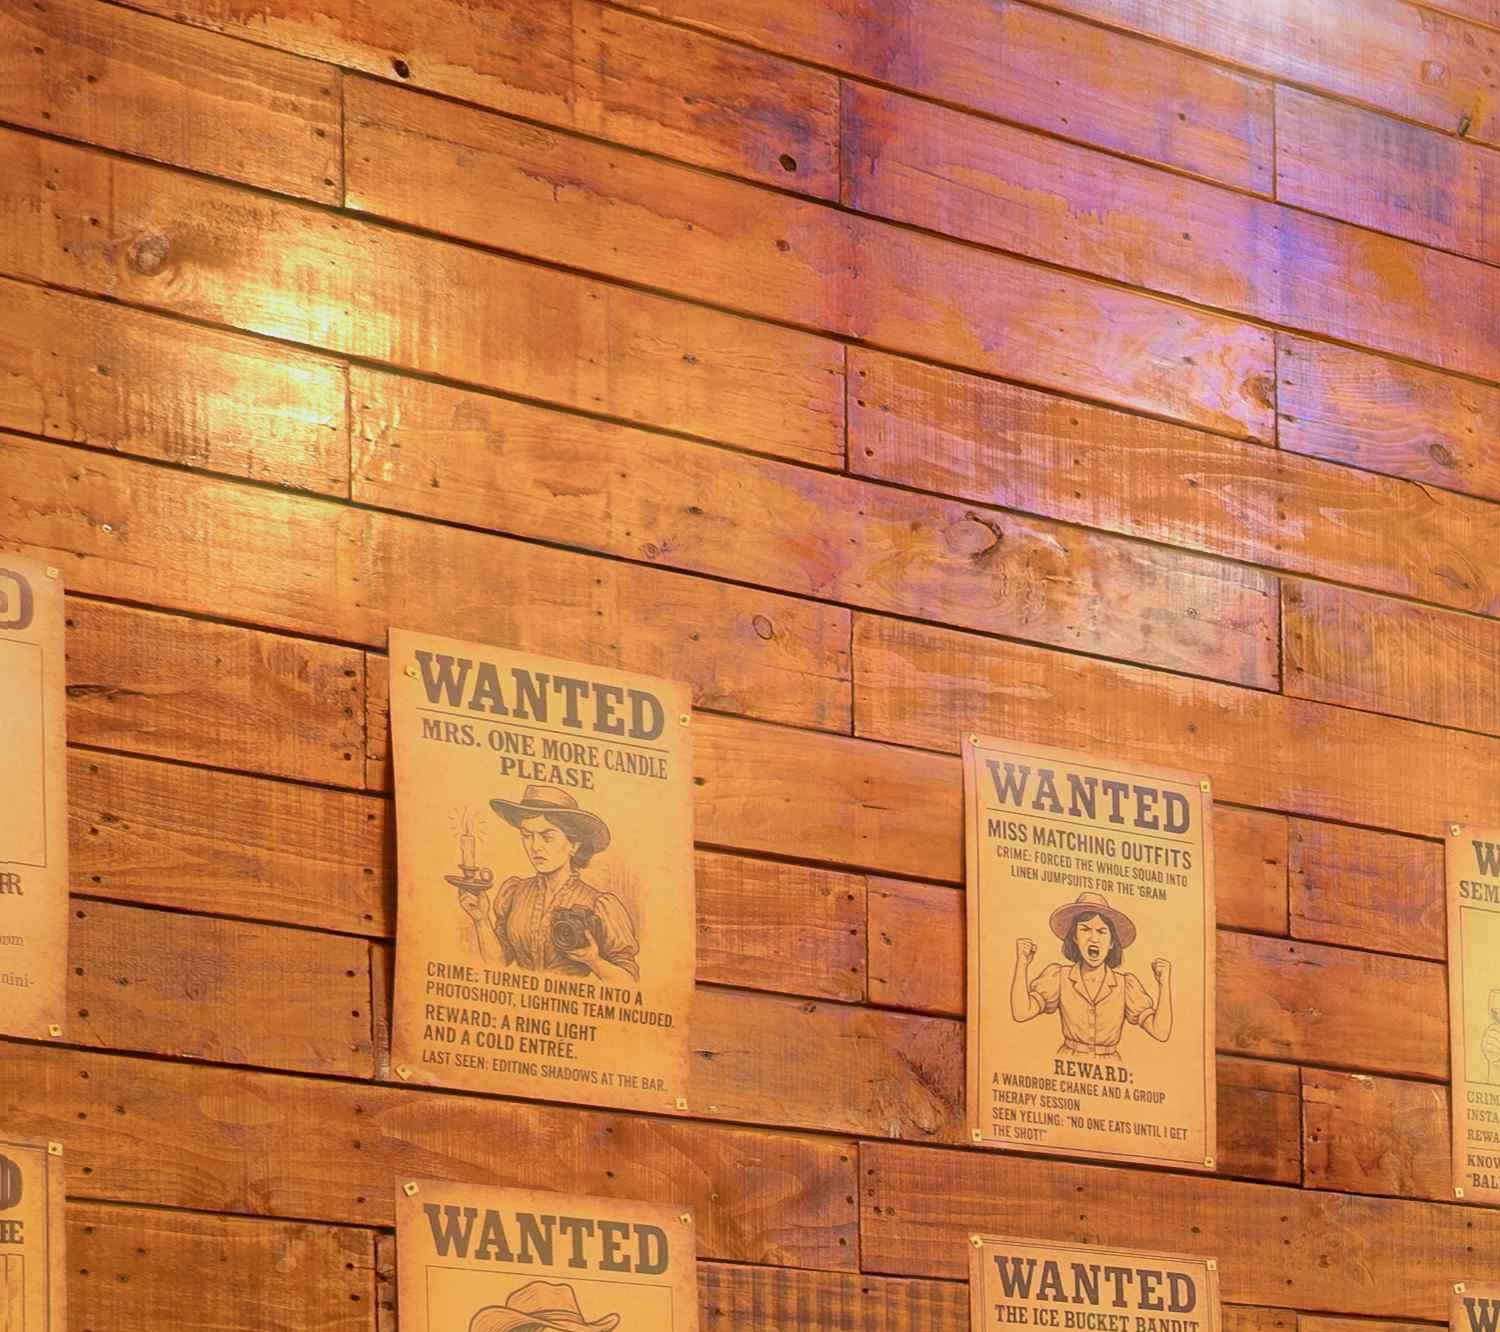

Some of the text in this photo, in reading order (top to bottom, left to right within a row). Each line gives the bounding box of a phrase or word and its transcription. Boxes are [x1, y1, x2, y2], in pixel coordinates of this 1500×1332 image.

[415, 650, 664, 741] WANTED
[421, 717, 668, 779] MRS. ONE MORE CANDLE
[500, 755, 594, 789] PLEASE
[985, 759, 1190, 834] WANTED
[988, 819, 1192, 869] MISS MATCHING OUTFITS
[997, 845, 1188, 887] CRIME: FORCED THE WHOLE SQUAD INTO
[427, 961, 643, 1005] CRIME: TURNED DINNER INTO A
[424, 1025, 456, 1043] AND
[460, 1030, 470, 1045] A
[476, 1031, 514, 1051] COLD
[425, 1004, 598, 1041] REWARD: A RING LIGHT
[1054, 1059, 1134, 1084] REWARD:
[424, 1203, 668, 1275] WANTED
[994, 1255, 1197, 1313] WANTED
[995, 1305, 1027, 1324] THE
[1033, 1308, 1059, 1327] ICE
[1064, 1311, 1130, 1332] BUCKET
